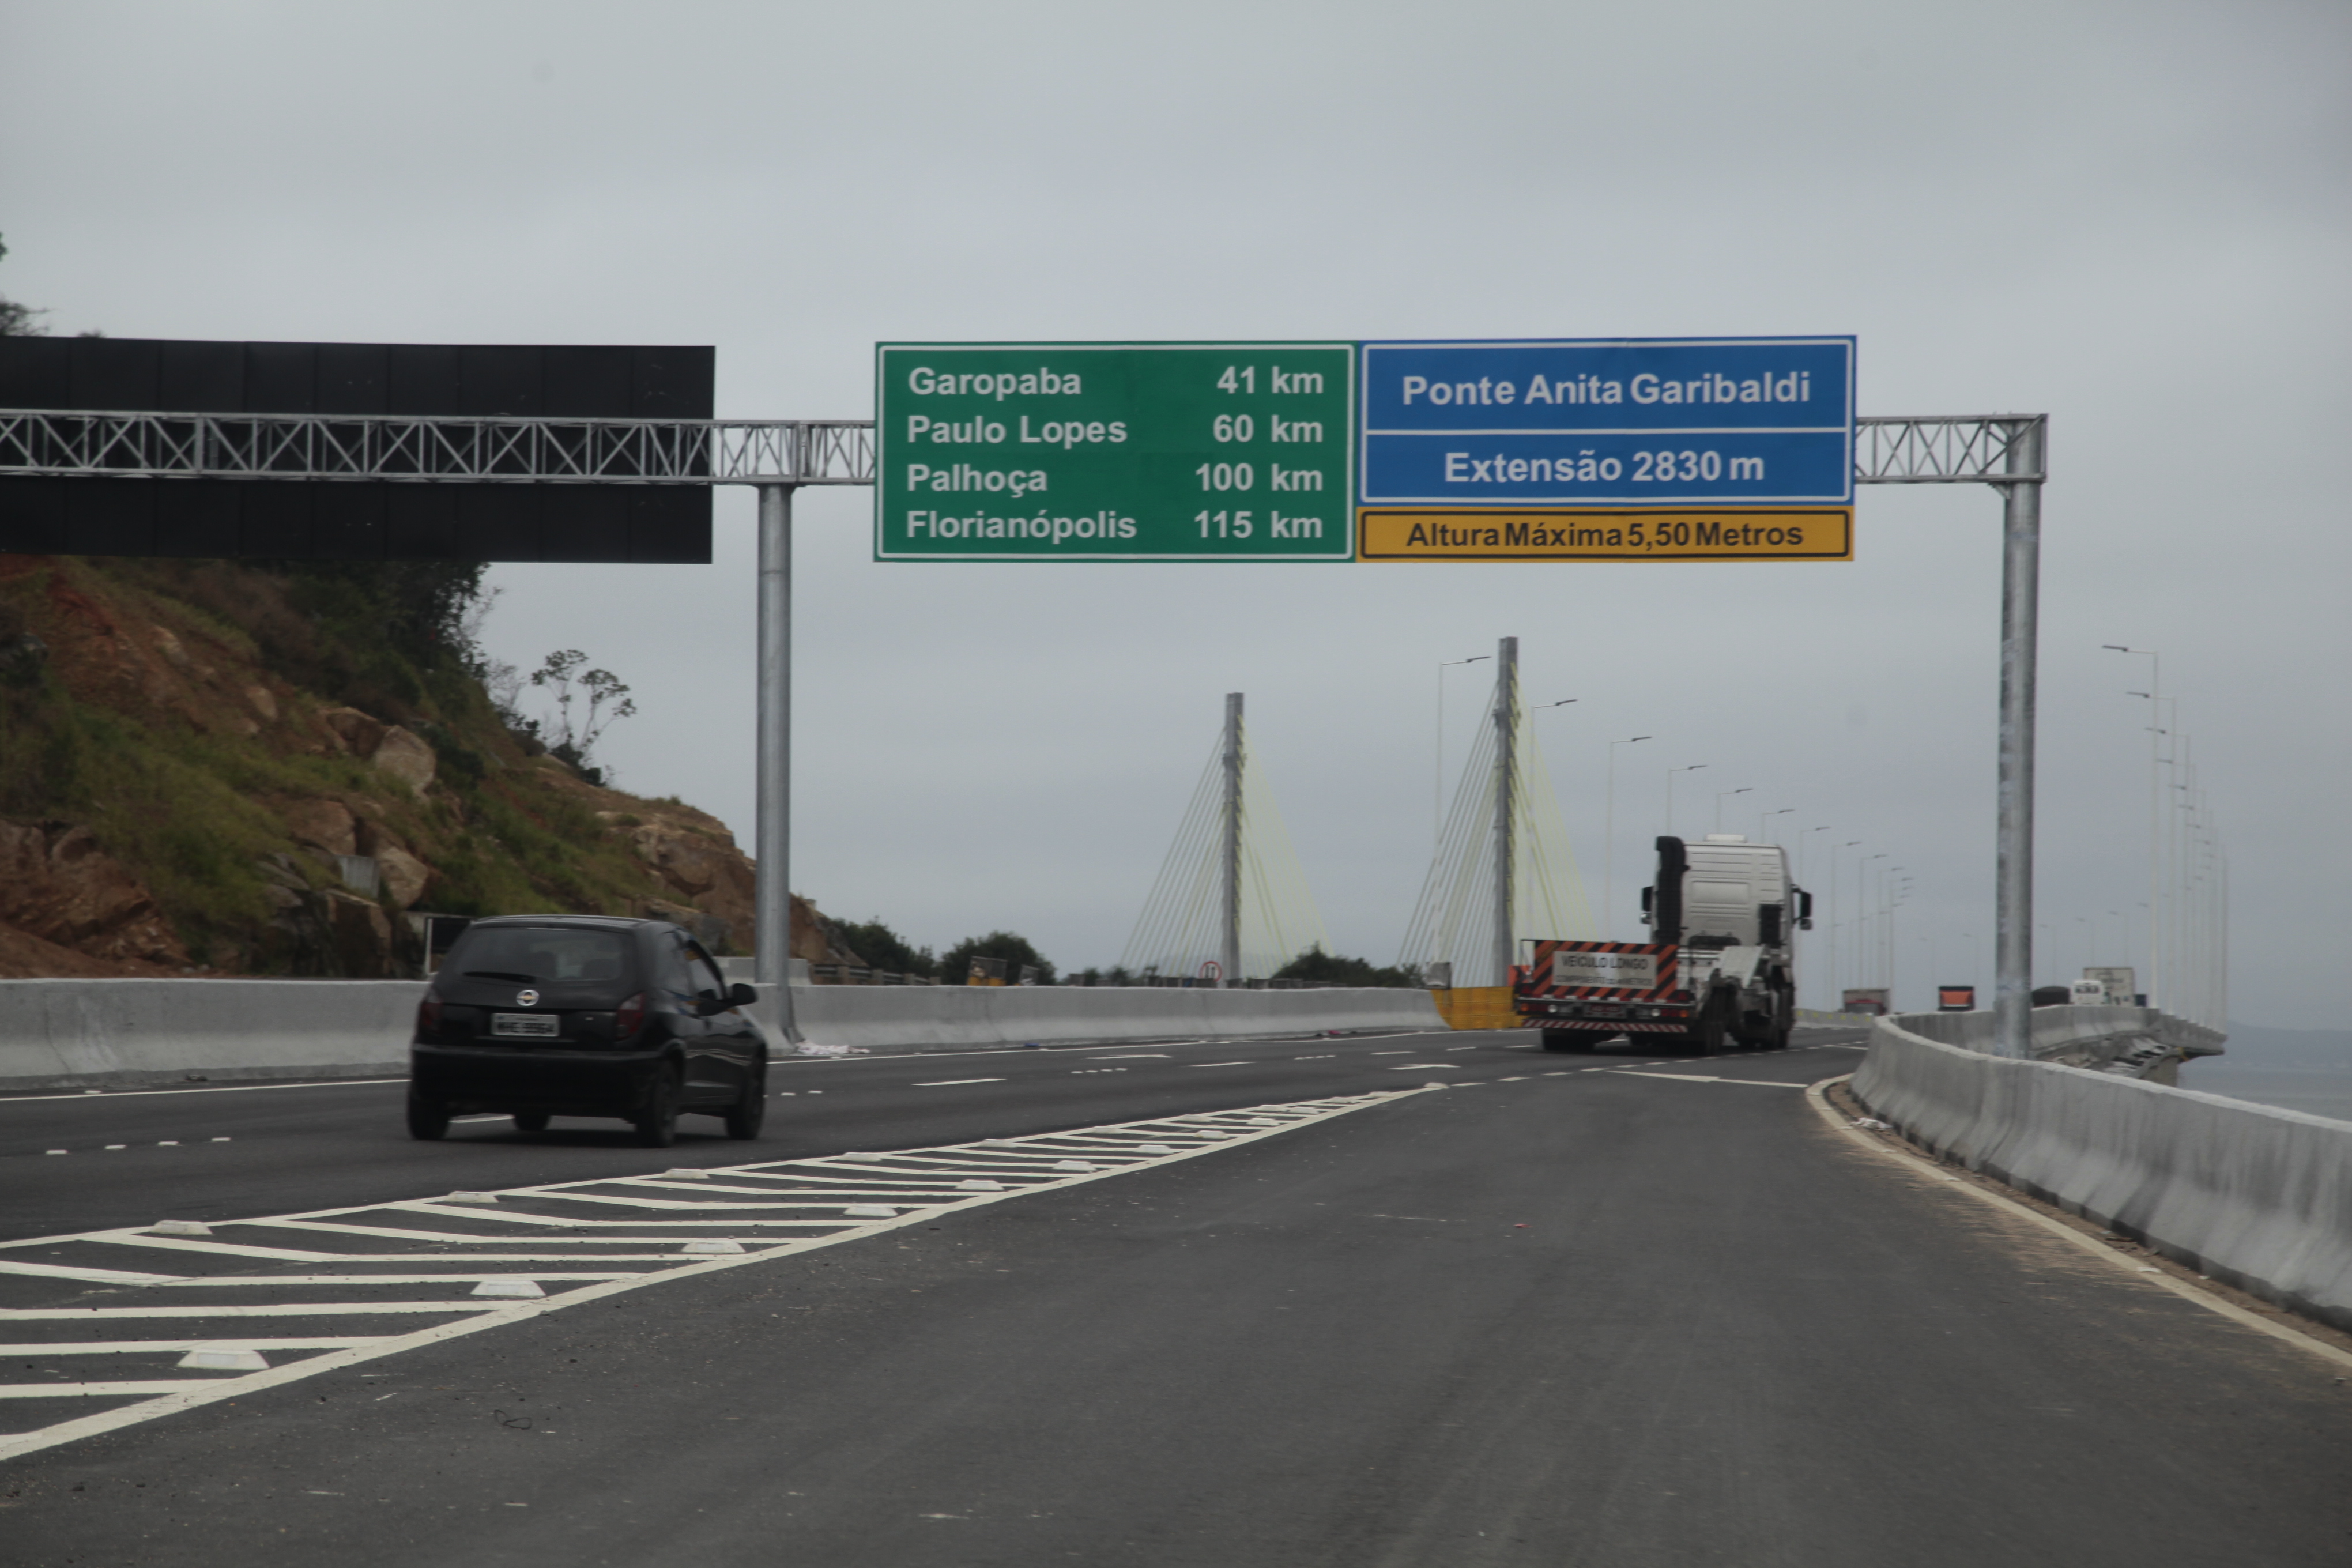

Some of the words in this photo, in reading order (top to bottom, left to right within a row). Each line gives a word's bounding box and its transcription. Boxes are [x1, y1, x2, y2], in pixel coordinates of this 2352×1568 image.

[908, 367, 1081, 402] Garopaba
[1216, 365, 1254, 394] 41
[1272, 365, 1324, 394] km
[1403, 376, 1516, 405] Ponte
[1524, 374, 1623, 405] Anita
[1630, 371, 1810, 404] Garibaldi
[908, 415, 1007, 444] Paulo
[1020, 415, 1128, 450] Lopes
[1213, 414, 1254, 443] 60
[1271, 414, 1323, 443] km
[907, 463, 1047, 499] Palhoça
[1196, 462, 1254, 491] 100
[1271, 463, 1323, 491] km
[1445, 450, 1622, 483] Extensão
[1631, 450, 1722, 482] 2830
[1729, 457, 1764, 480] m
[907, 509, 1137, 545] Florianópolis
[1194, 510, 1253, 538] 115
[1271, 510, 1322, 538] km
[1406, 523, 1499, 547] Altura
[1505, 522, 1622, 547] Máxima
[1627, 522, 1690, 551] 5,50
[1695, 522, 1803, 546] Metros
[1611, 958, 1648, 970] LONGO
